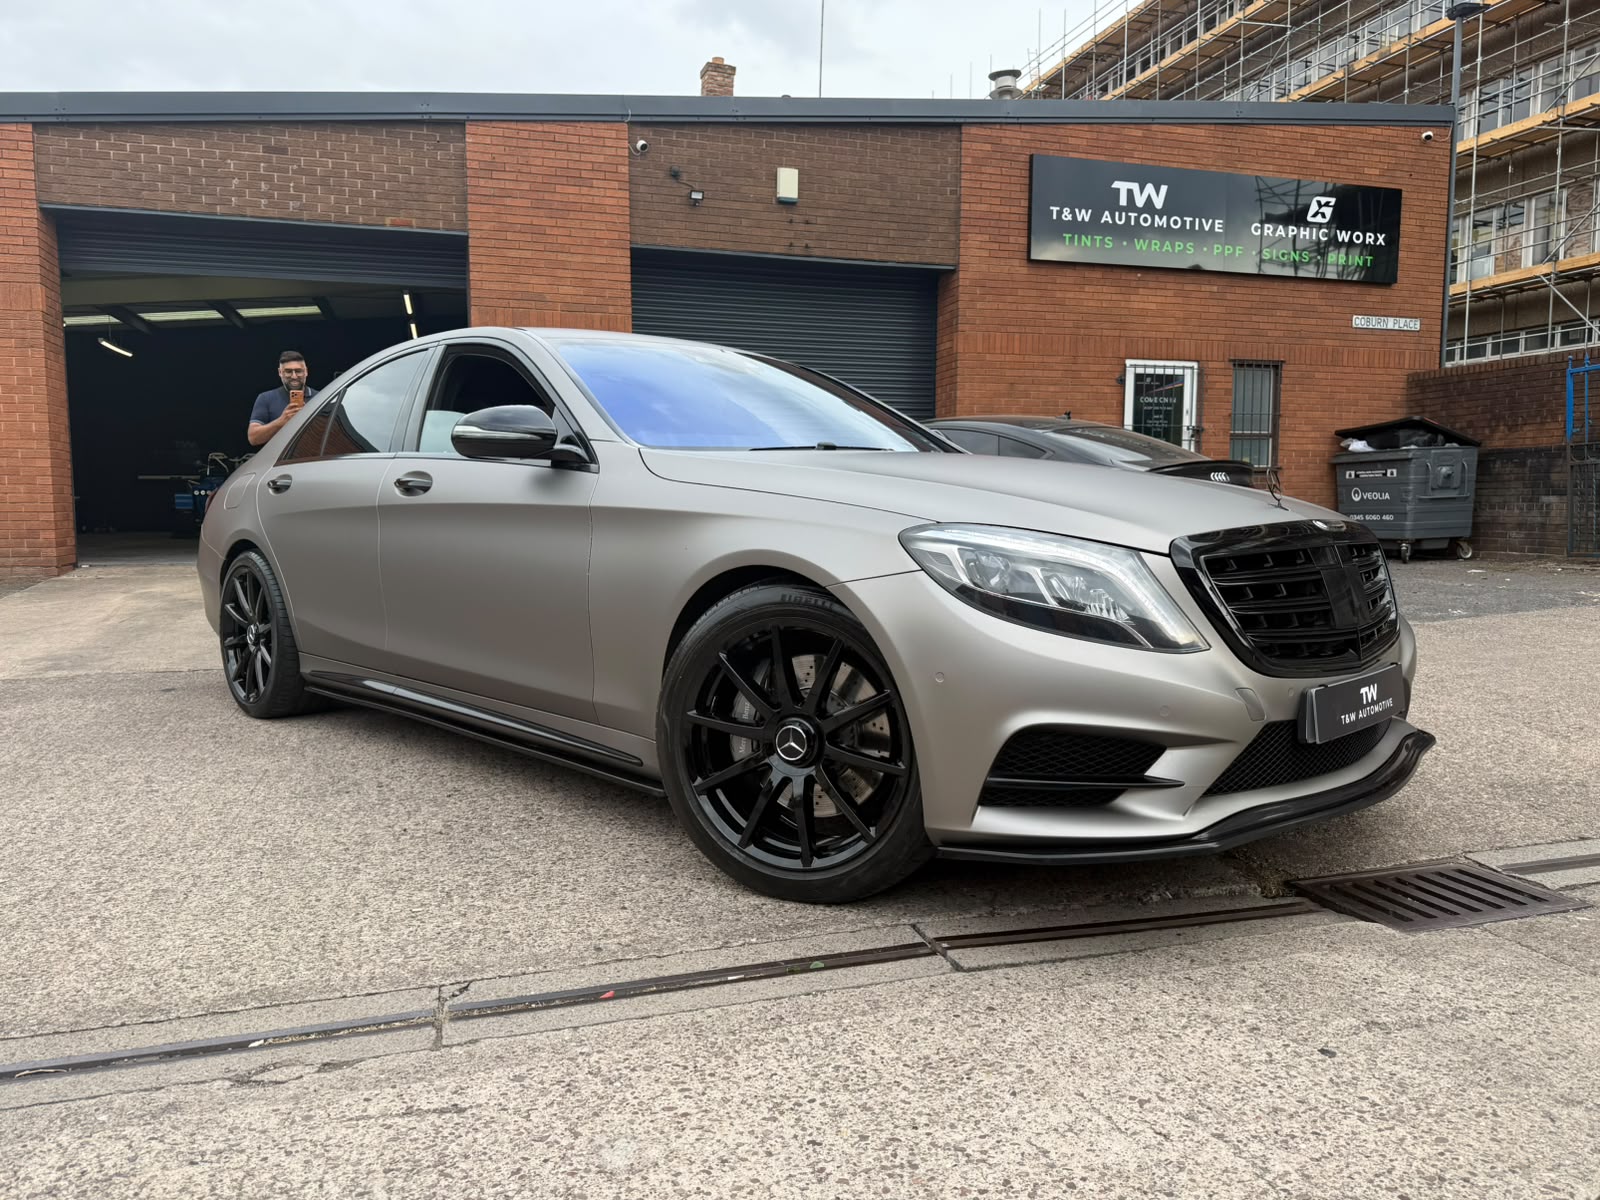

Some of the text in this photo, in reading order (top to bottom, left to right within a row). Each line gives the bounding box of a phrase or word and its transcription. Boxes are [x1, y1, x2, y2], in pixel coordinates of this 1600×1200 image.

[1110, 180, 1168, 210] TW
[1049, 206, 1224, 233] T&W AUTOMOTIVE
[1250, 222, 1386, 246] GRAPHIC WORX
[1062, 233, 1374, 267] TINTS WRAPS PPF SIGNS PRINT
[1354, 317, 1418, 330] COBURN PLACE
[1362, 492, 1390, 500] VEOLIA
[1360, 683, 1377, 704] TW
[1340, 697, 1393, 725] T&W AUTOMOTIVE
